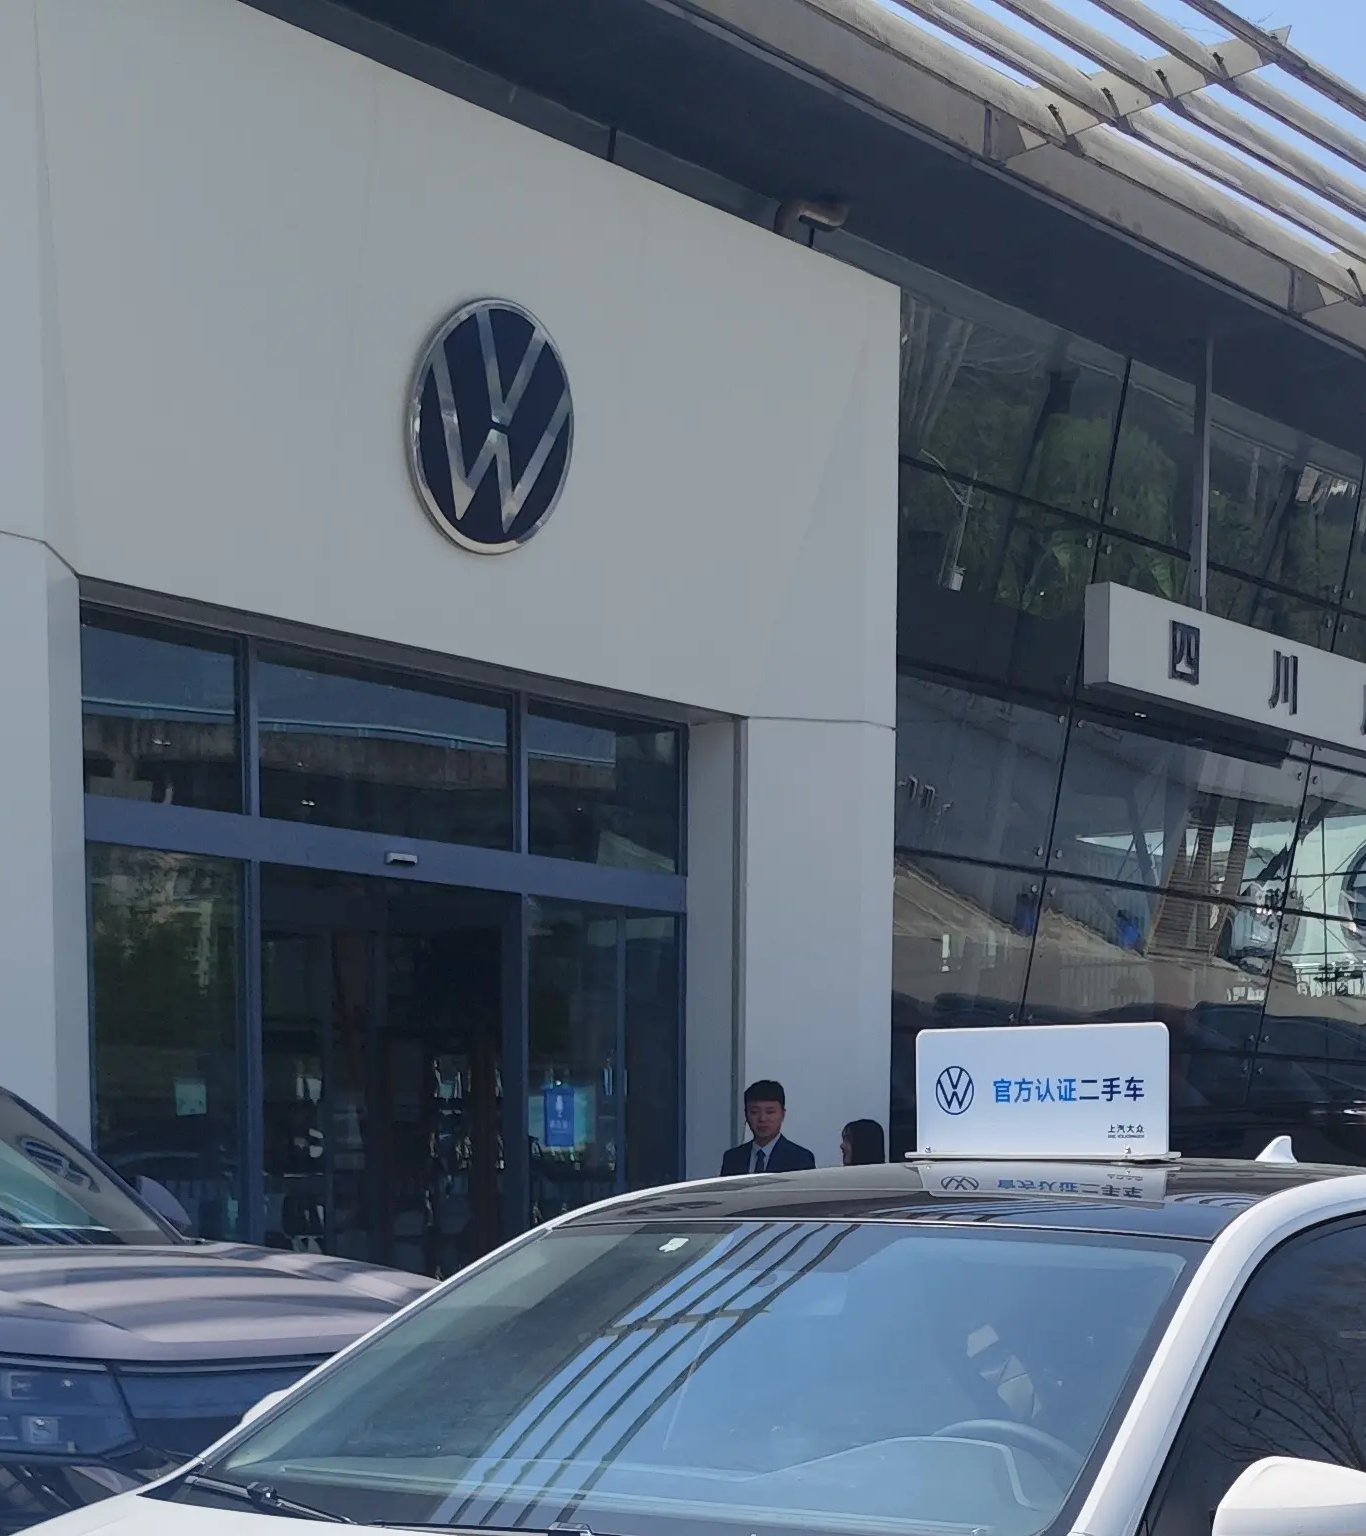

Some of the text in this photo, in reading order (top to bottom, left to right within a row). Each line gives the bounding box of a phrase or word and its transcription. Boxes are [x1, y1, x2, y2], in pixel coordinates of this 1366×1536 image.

[993, 1076, 1145, 1103] 官方认证二手车
[1107, 1123, 1145, 1134] 上汽大众
